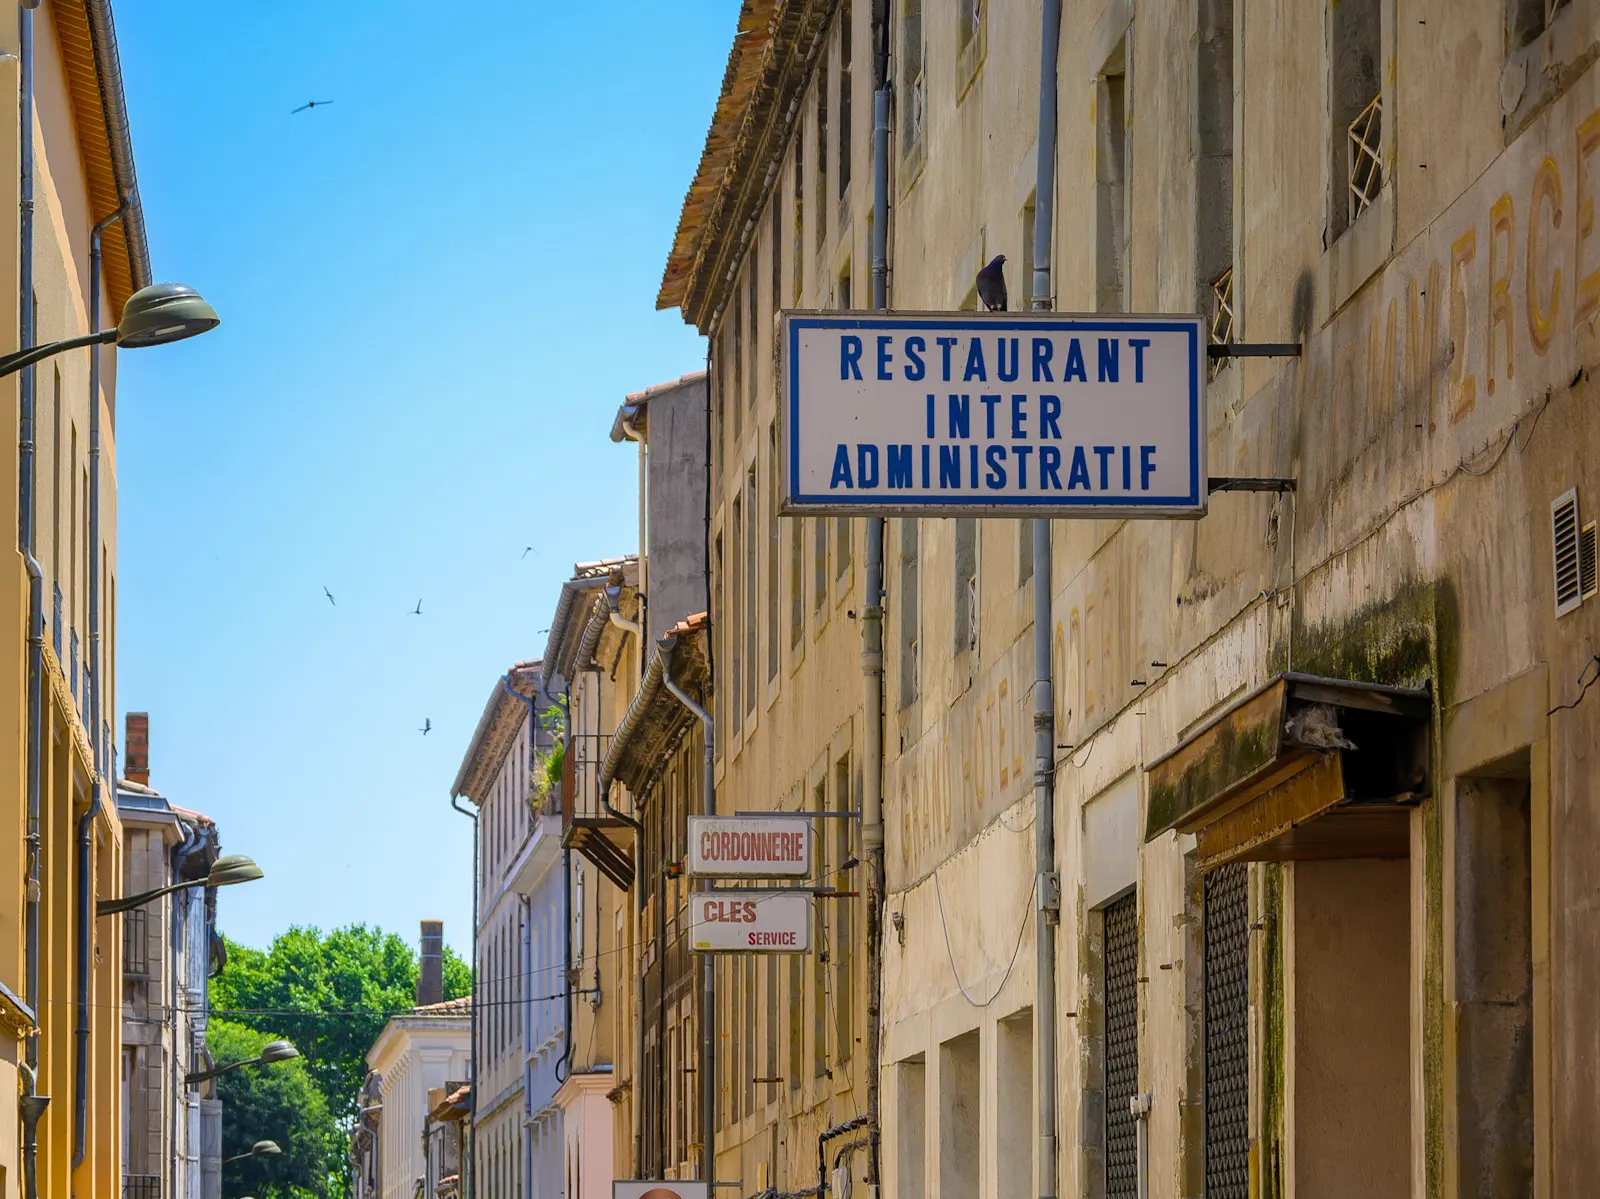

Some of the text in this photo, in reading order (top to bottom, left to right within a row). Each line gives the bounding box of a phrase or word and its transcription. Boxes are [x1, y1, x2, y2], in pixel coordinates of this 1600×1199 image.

[840, 335, 1151, 383] RESTAURANT
[926, 394, 1062, 440] INTER
[830, 443, 1157, 491] ADMINISTRATIF
[700, 831, 804, 862] CORDONNERIE
[703, 901, 757, 923] CLES
[748, 931, 797, 946] SERVICE
